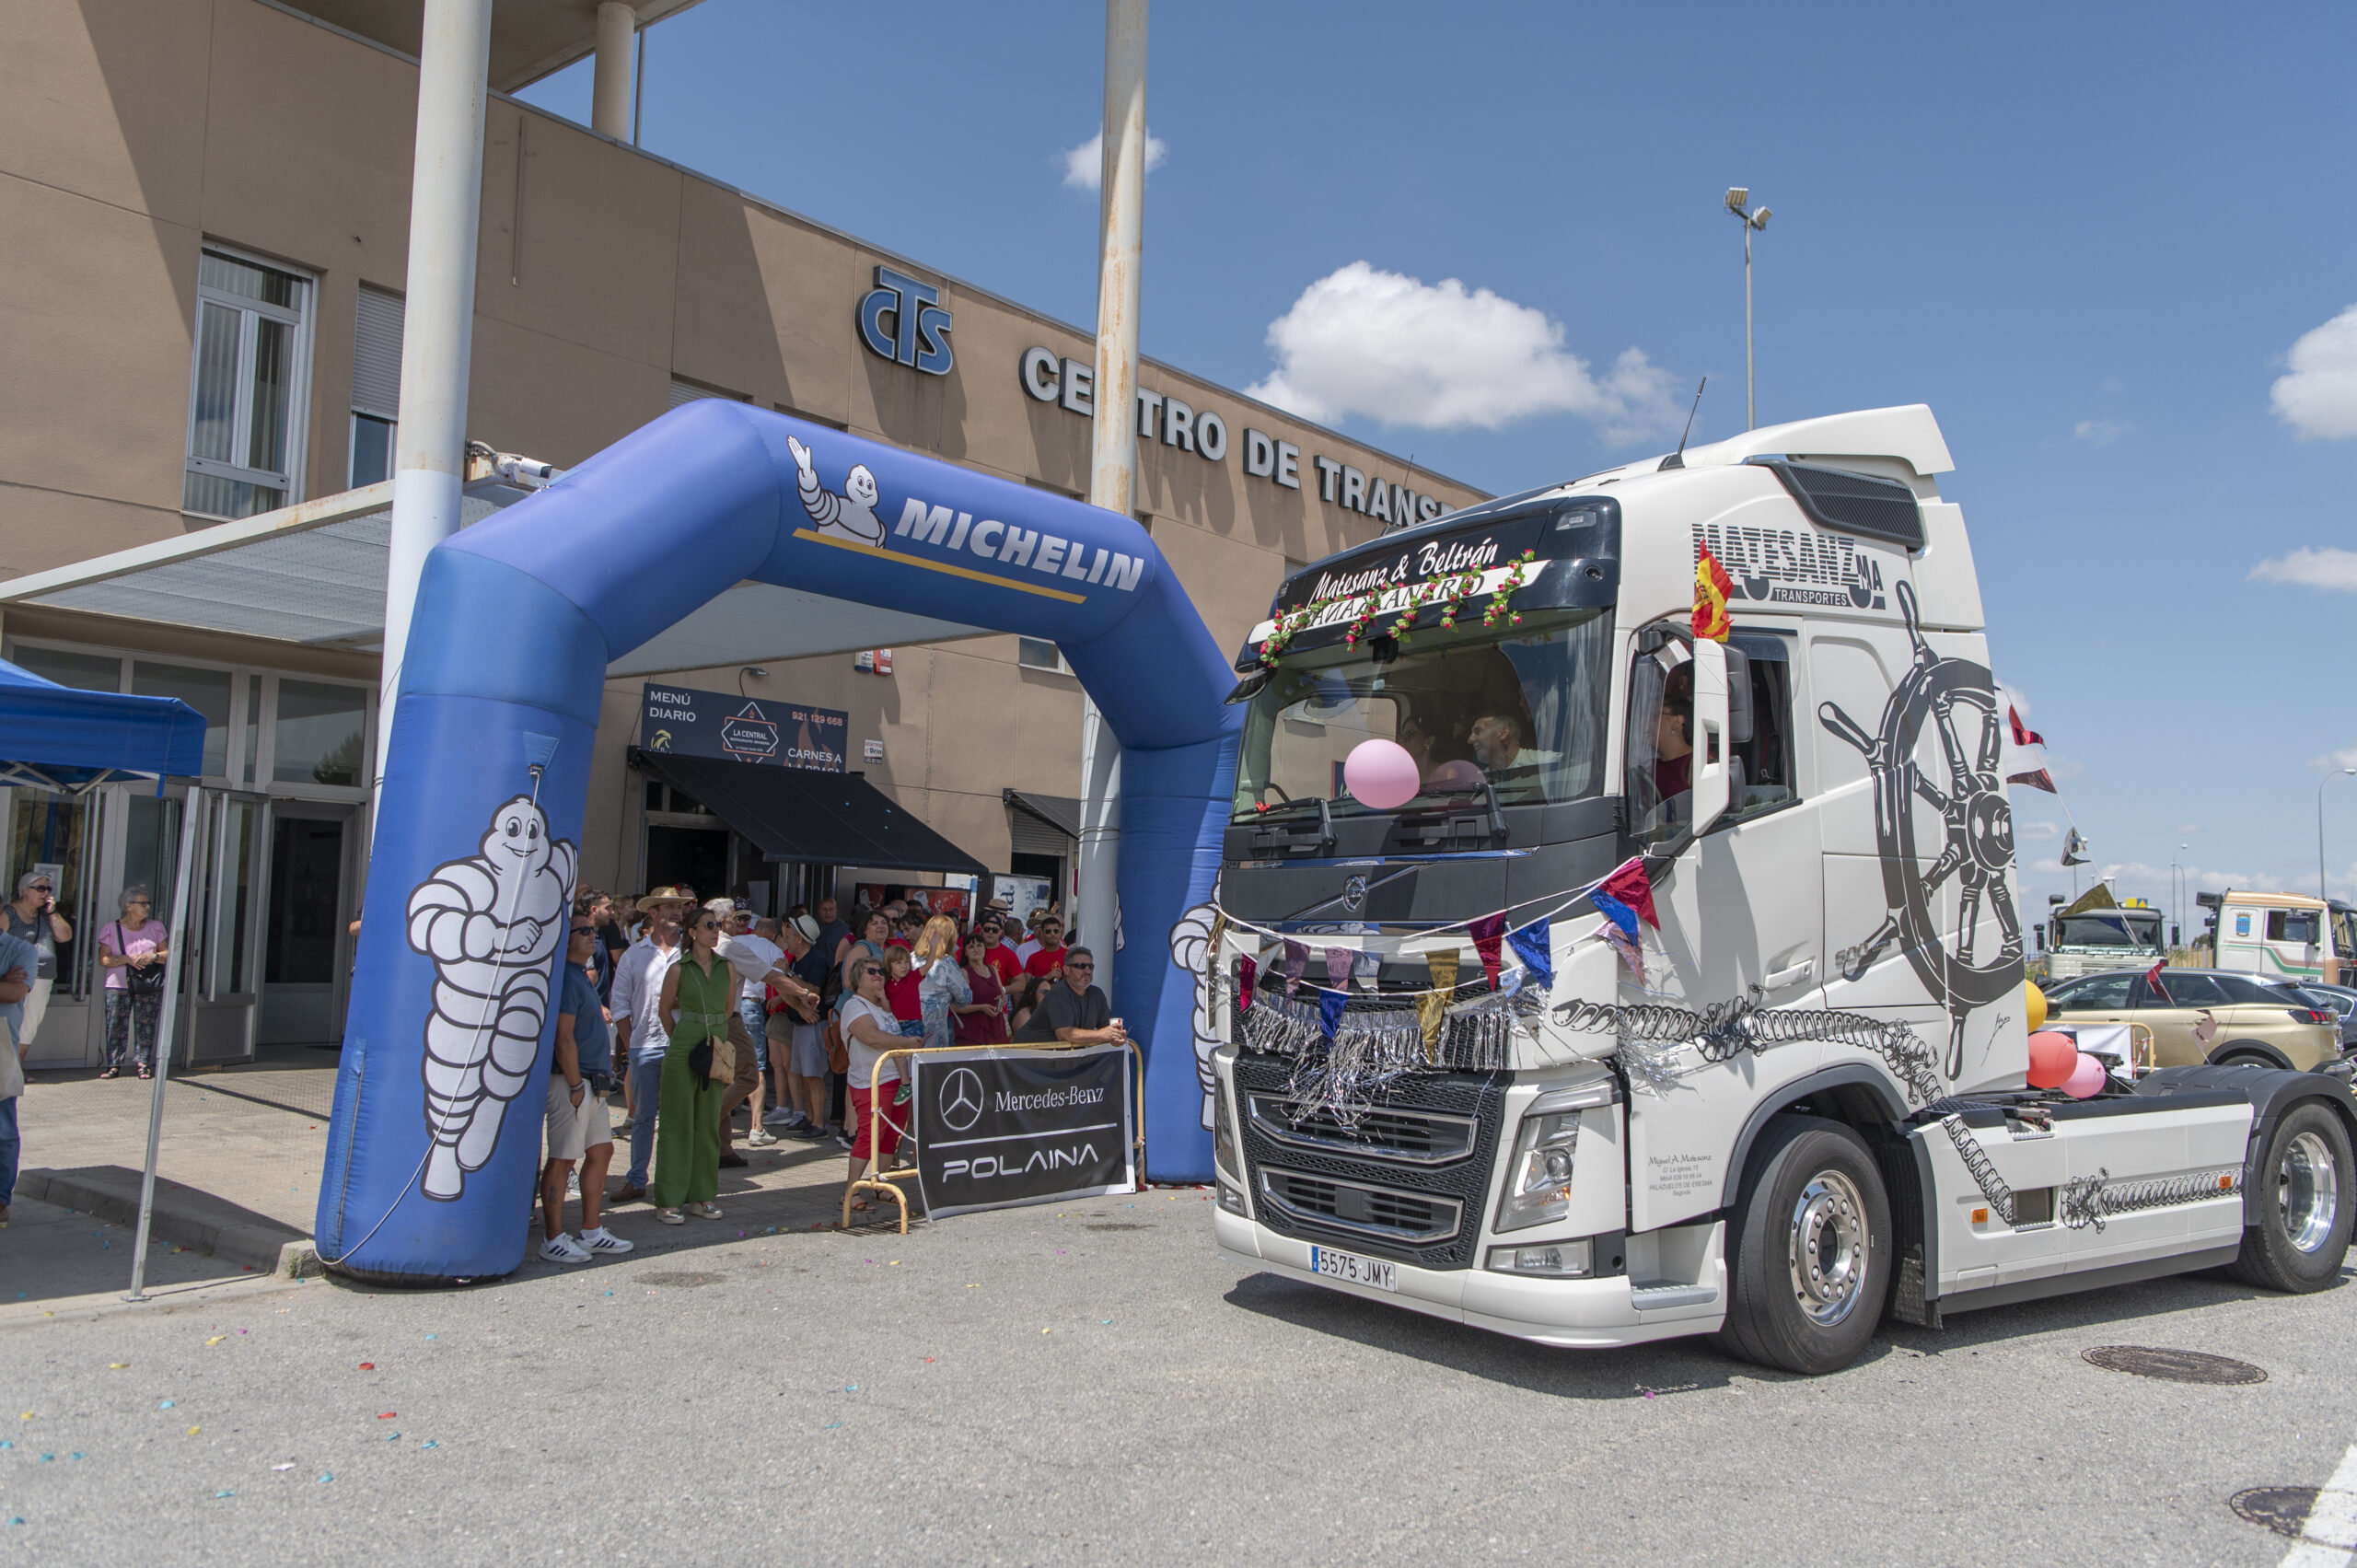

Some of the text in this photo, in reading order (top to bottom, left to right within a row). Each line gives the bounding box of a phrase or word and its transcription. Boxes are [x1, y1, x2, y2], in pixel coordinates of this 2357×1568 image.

[1019, 345, 1457, 528] CETRO DE TRANS
[894, 497, 1144, 592] MICHELIN
[1306, 537, 1499, 610] Matesanz & Beltrán
[1774, 588, 1847, 606] TRANSPORTES
[649, 690, 691, 706] MENÚ
[649, 707, 697, 723] DIARIO
[792, 711, 807, 722] 921
[811, 714, 826, 724] 129
[741, 730, 767, 740] CENTRAL
[788, 748, 842, 764] CARNES A
[995, 1086, 1104, 1112] Mercedes-Benz
[942, 1143, 1099, 1184] POLAINA
[1680, 1154, 1712, 1164] Matesanz
[1320, 1250, 1391, 1287] 5575 JMY
